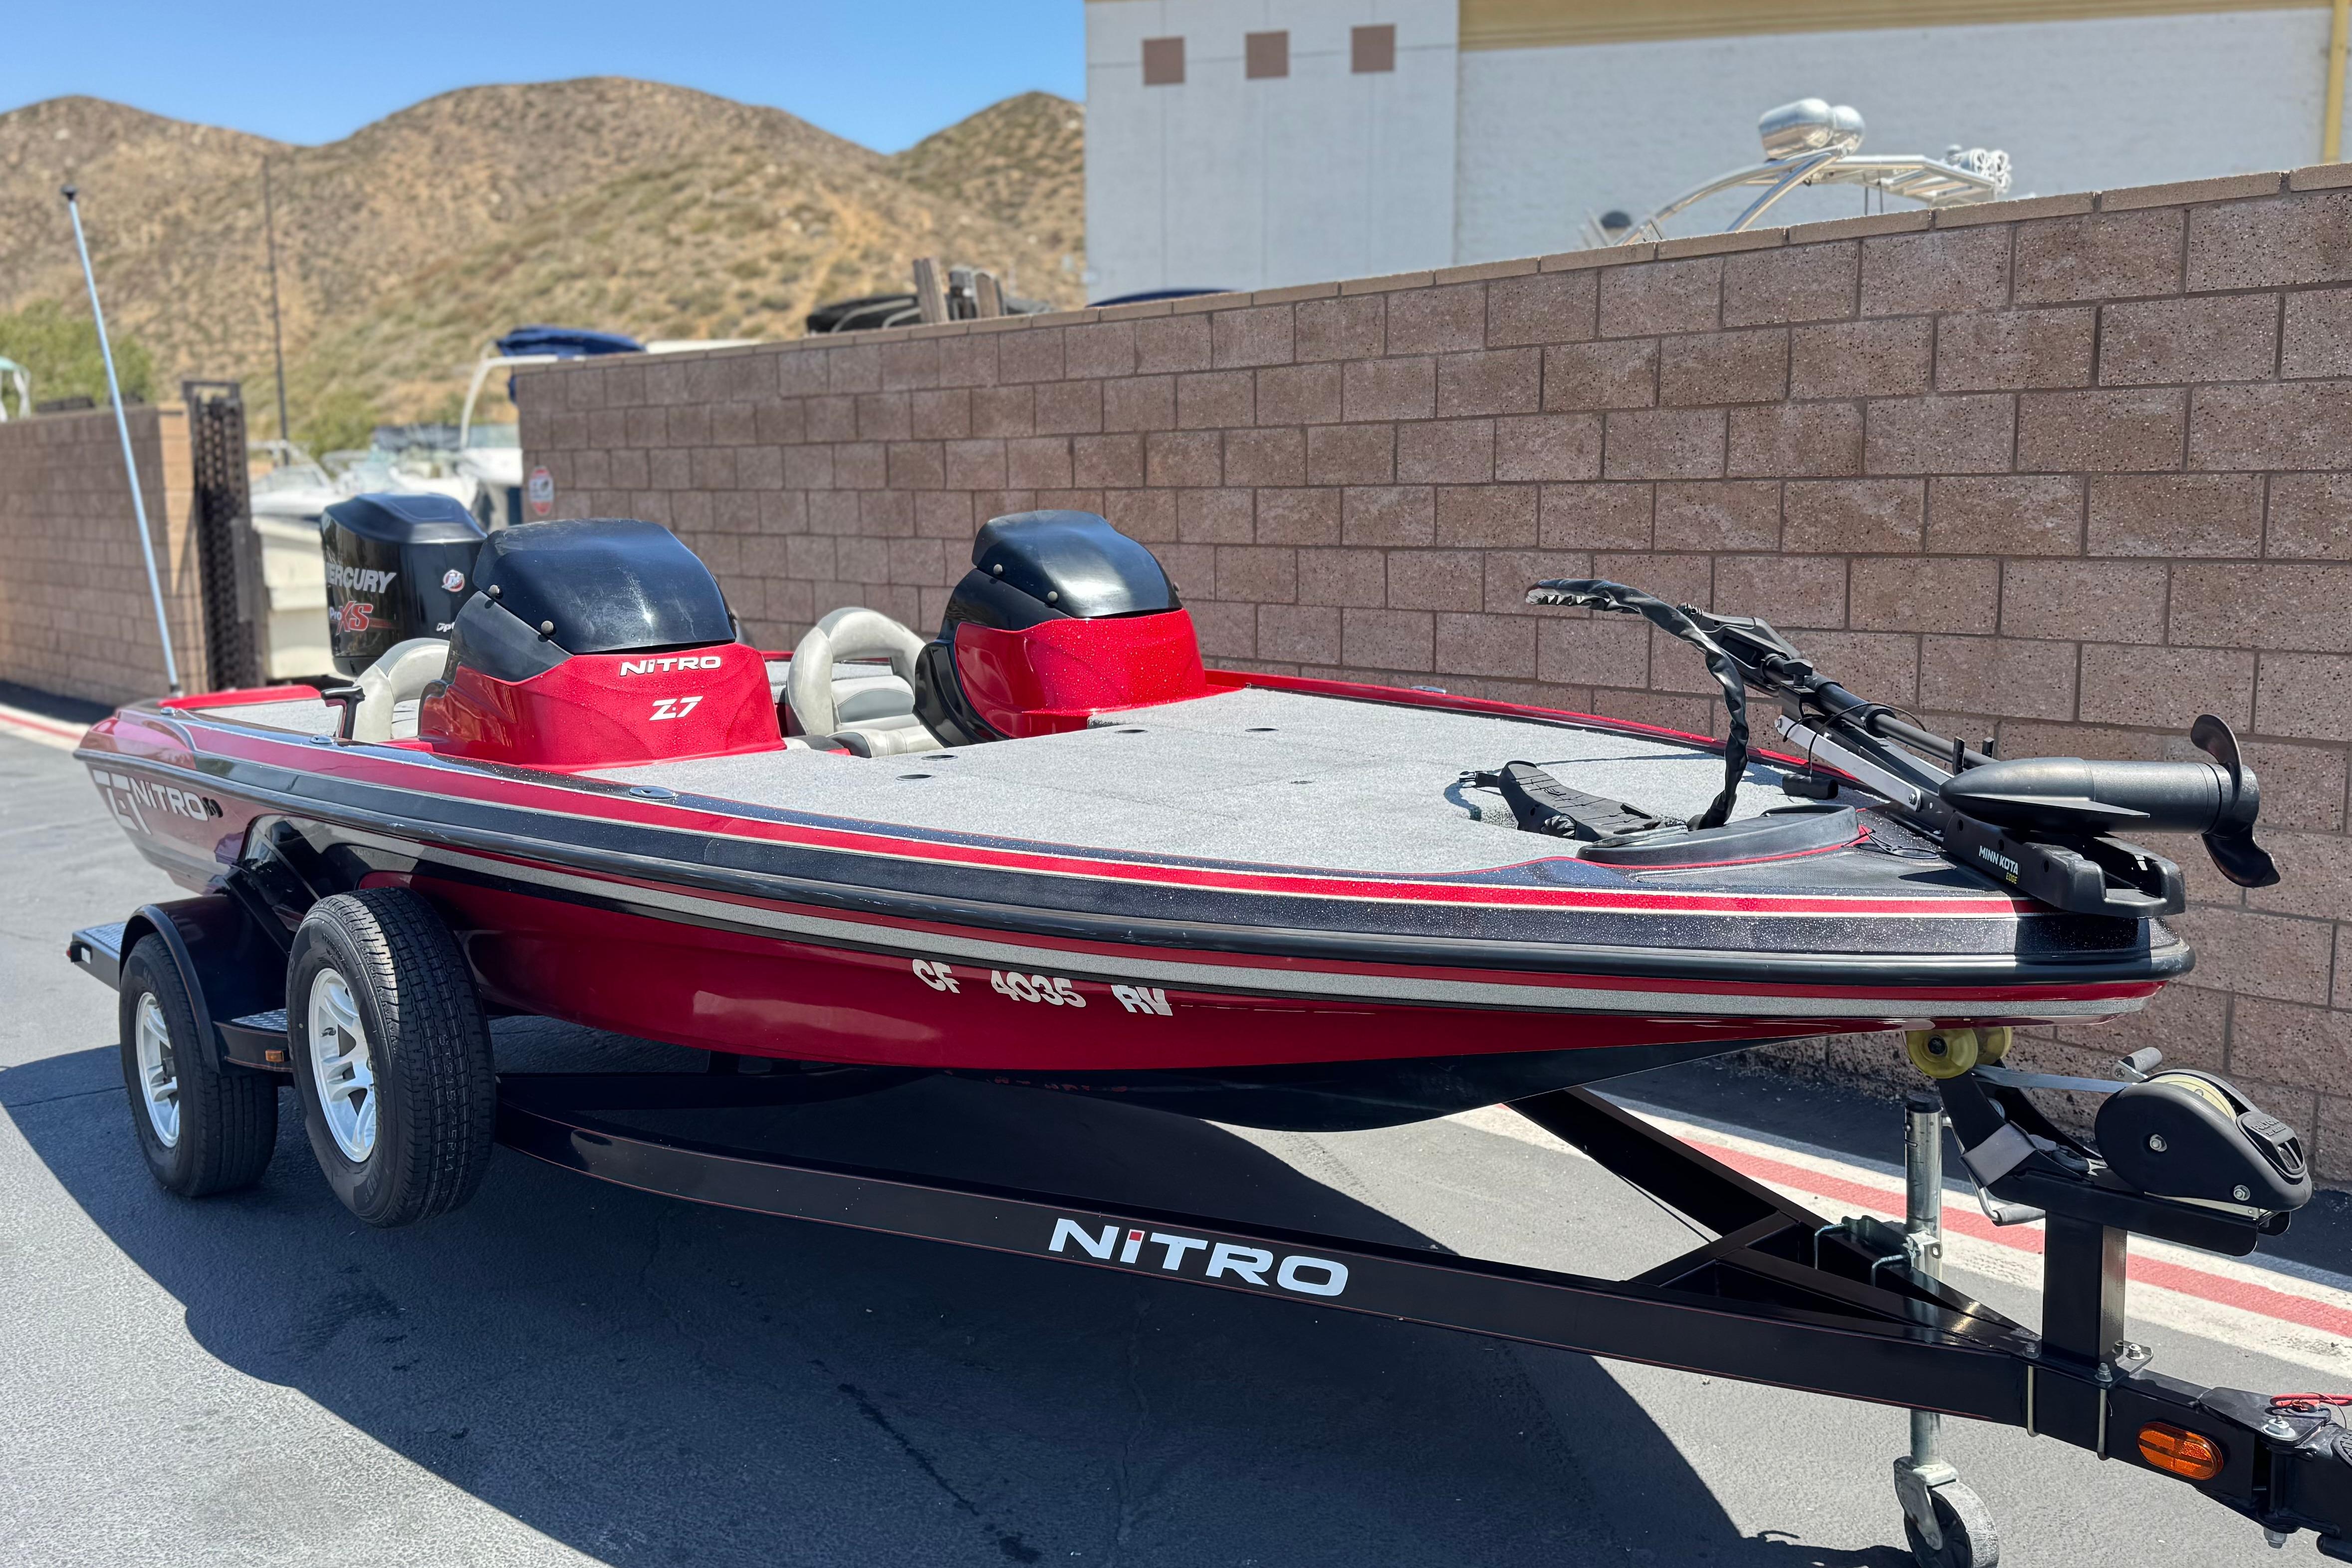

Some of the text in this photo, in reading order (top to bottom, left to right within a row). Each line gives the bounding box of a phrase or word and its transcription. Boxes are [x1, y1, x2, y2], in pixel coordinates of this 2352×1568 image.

[620, 656, 721, 676] NITRO
[128, 777, 209, 821] NITRO
[1979, 845, 2019, 875] MINN KOTA
[2006, 872, 2018, 884] EDGE
[912, 959, 1173, 1016] CF 4035 RV
[1049, 1218, 1349, 1296] NITRO
